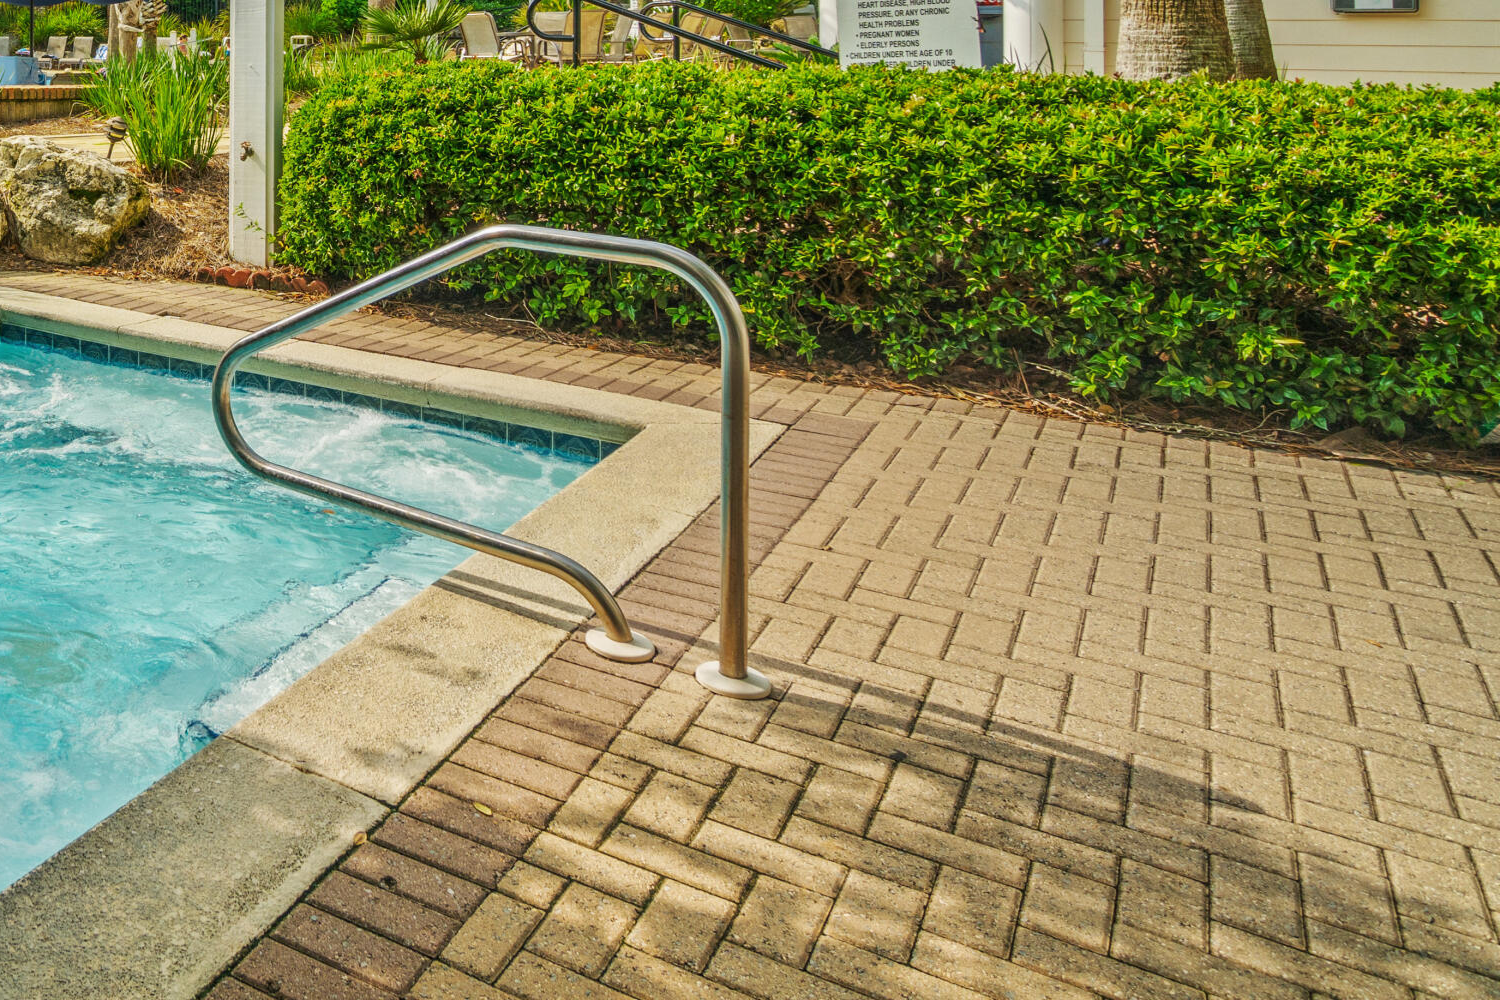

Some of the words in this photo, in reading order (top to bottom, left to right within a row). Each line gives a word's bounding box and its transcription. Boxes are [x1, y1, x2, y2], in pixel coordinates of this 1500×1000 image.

[857, 1, 879, 9] HEART
[880, 0, 908, 7] DISEASE,
[858, 10, 894, 19] PRESSURE,
[894, 9, 904, 17] OR
[920, 7, 950, 15] CHRONIC
[859, 21, 884, 29] HEALTH
[884, 19, 919, 28] PROBLEMS
[860, 31, 893, 39] PREGNANT
[860, 41, 888, 49] ELDERLY
[889, 40, 920, 48] PERSONS
[850, 51, 881, 59] CHILDREN
[882, 50, 904, 58] UNDER
[919, 49, 933, 57] AGE
[932, 59, 956, 67] UNDER
